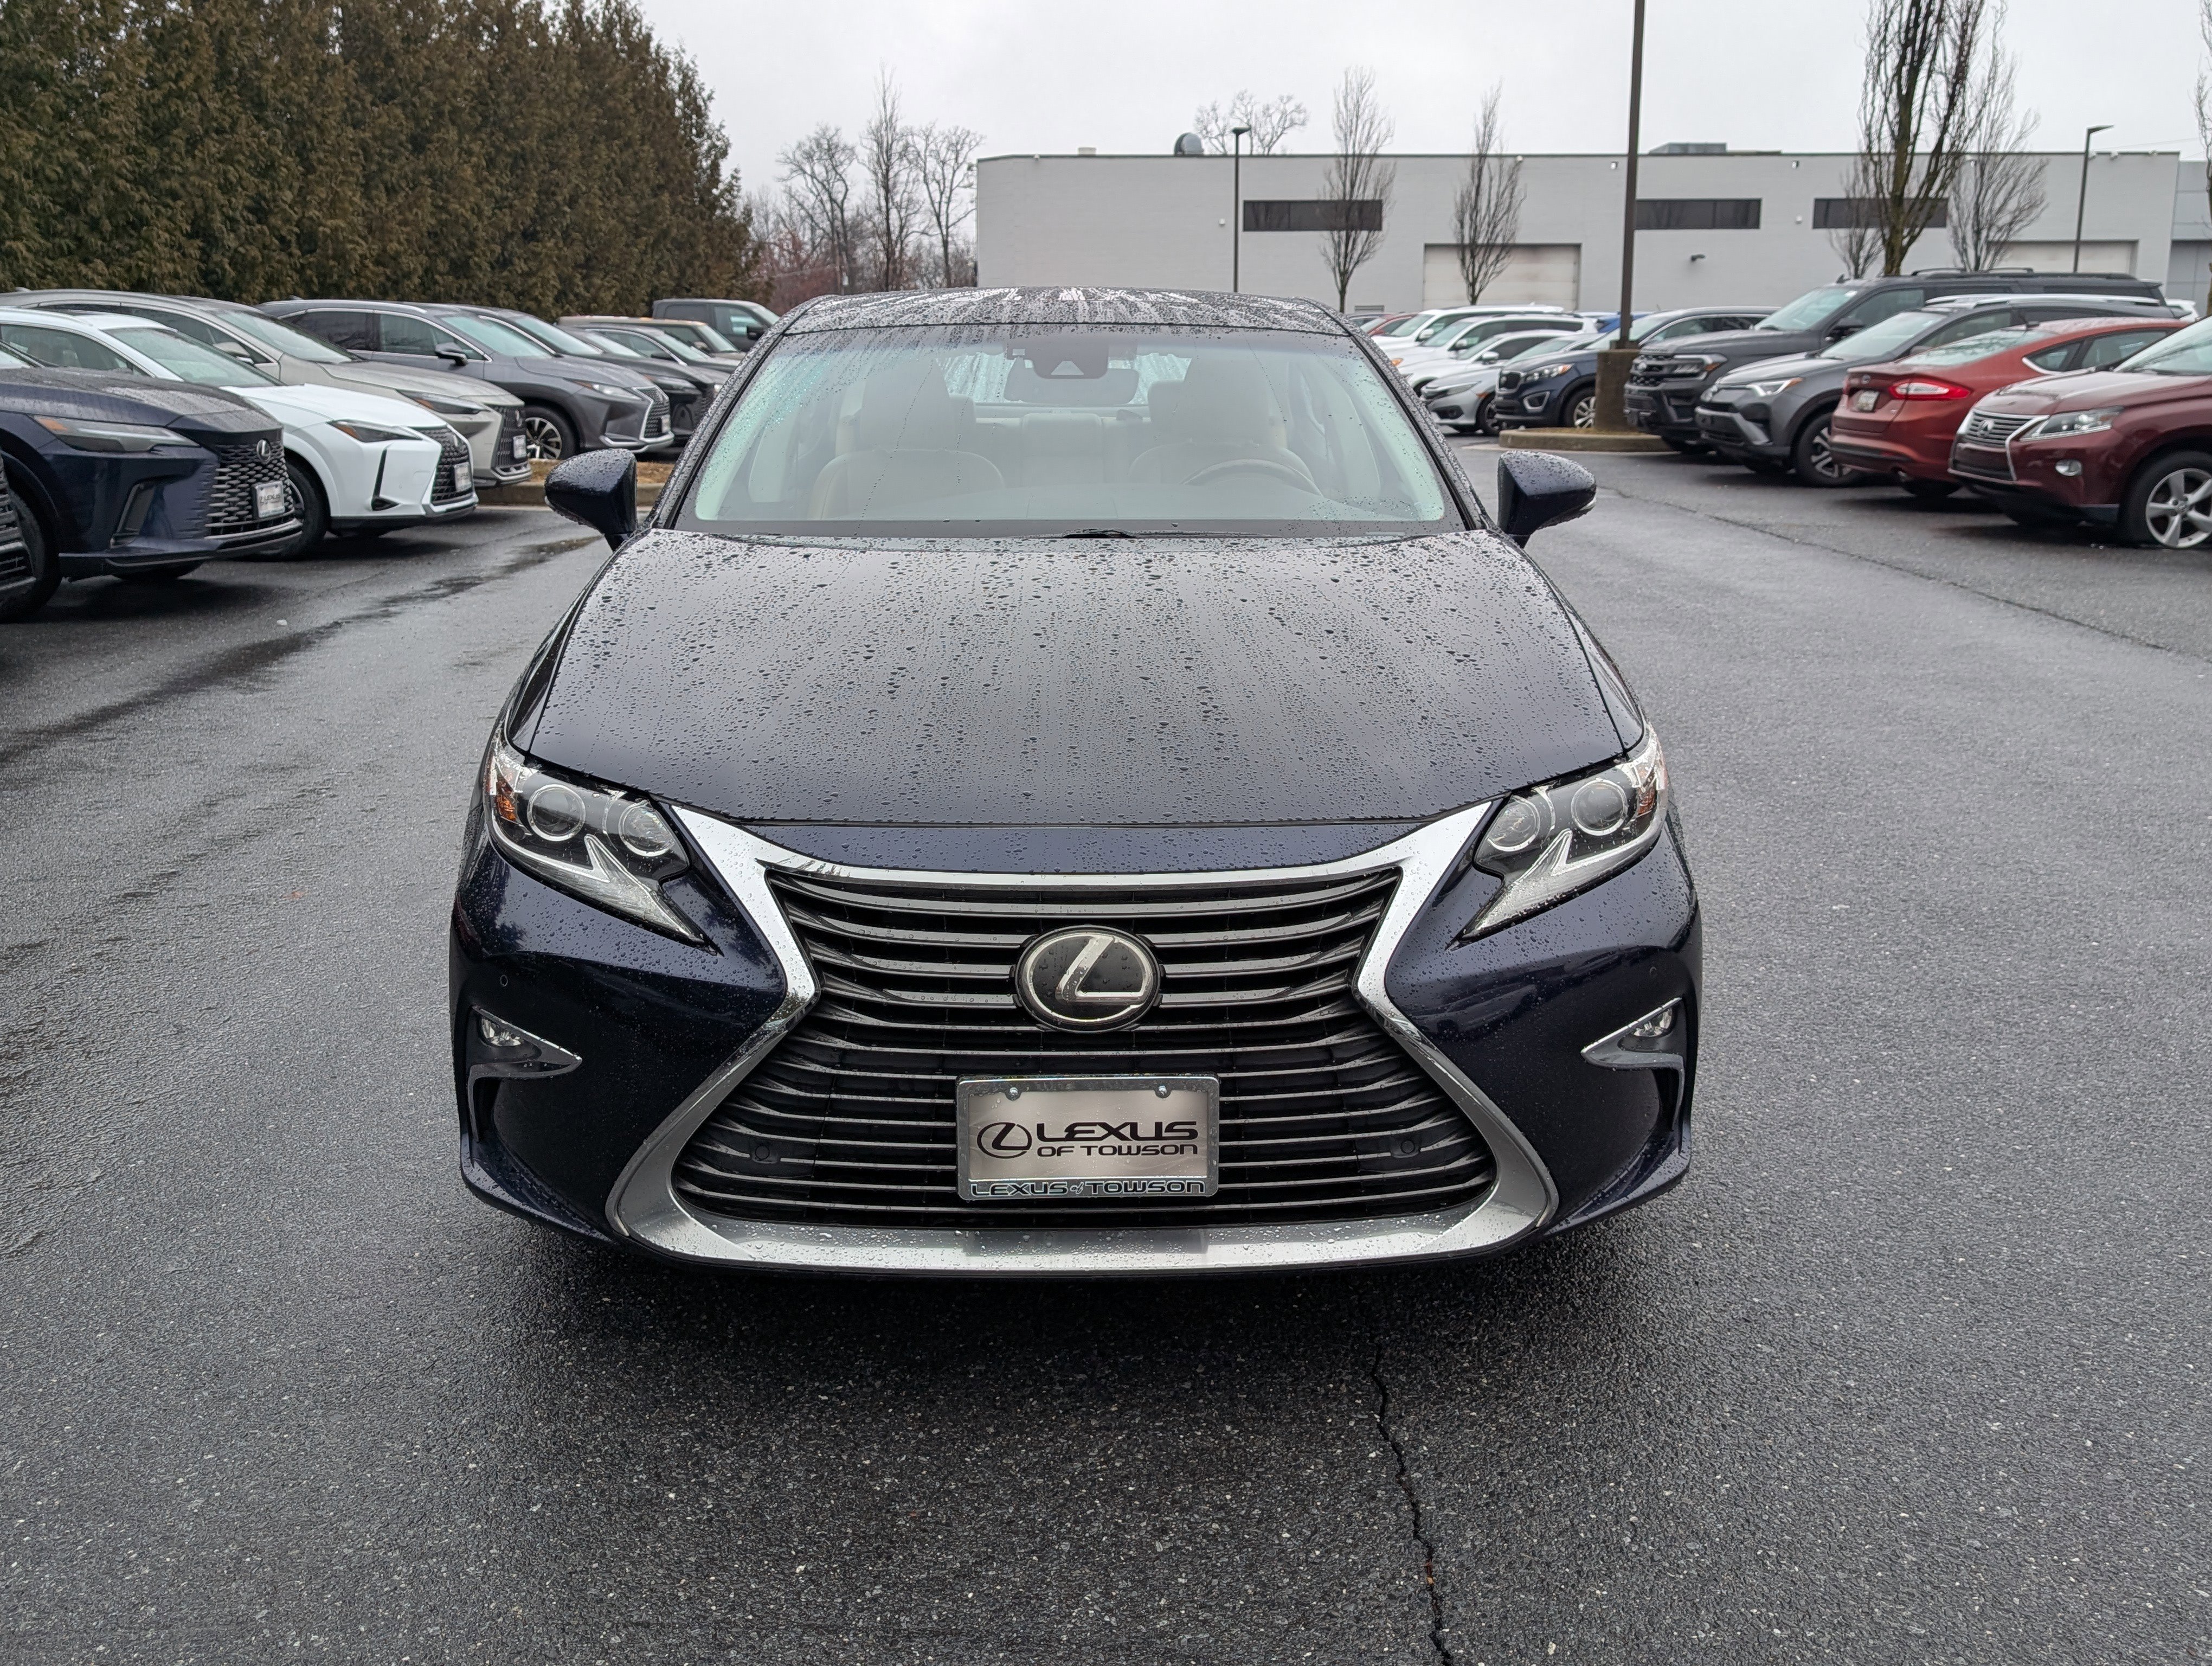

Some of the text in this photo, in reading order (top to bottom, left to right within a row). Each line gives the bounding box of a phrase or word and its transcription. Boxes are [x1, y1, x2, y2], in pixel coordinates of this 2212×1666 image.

[1037, 1122, 1198, 1142] LEXUS
[1037, 1144, 1198, 1157] OF TOWSON
[970, 1180, 1205, 1196] LEXUS of TOWSON
